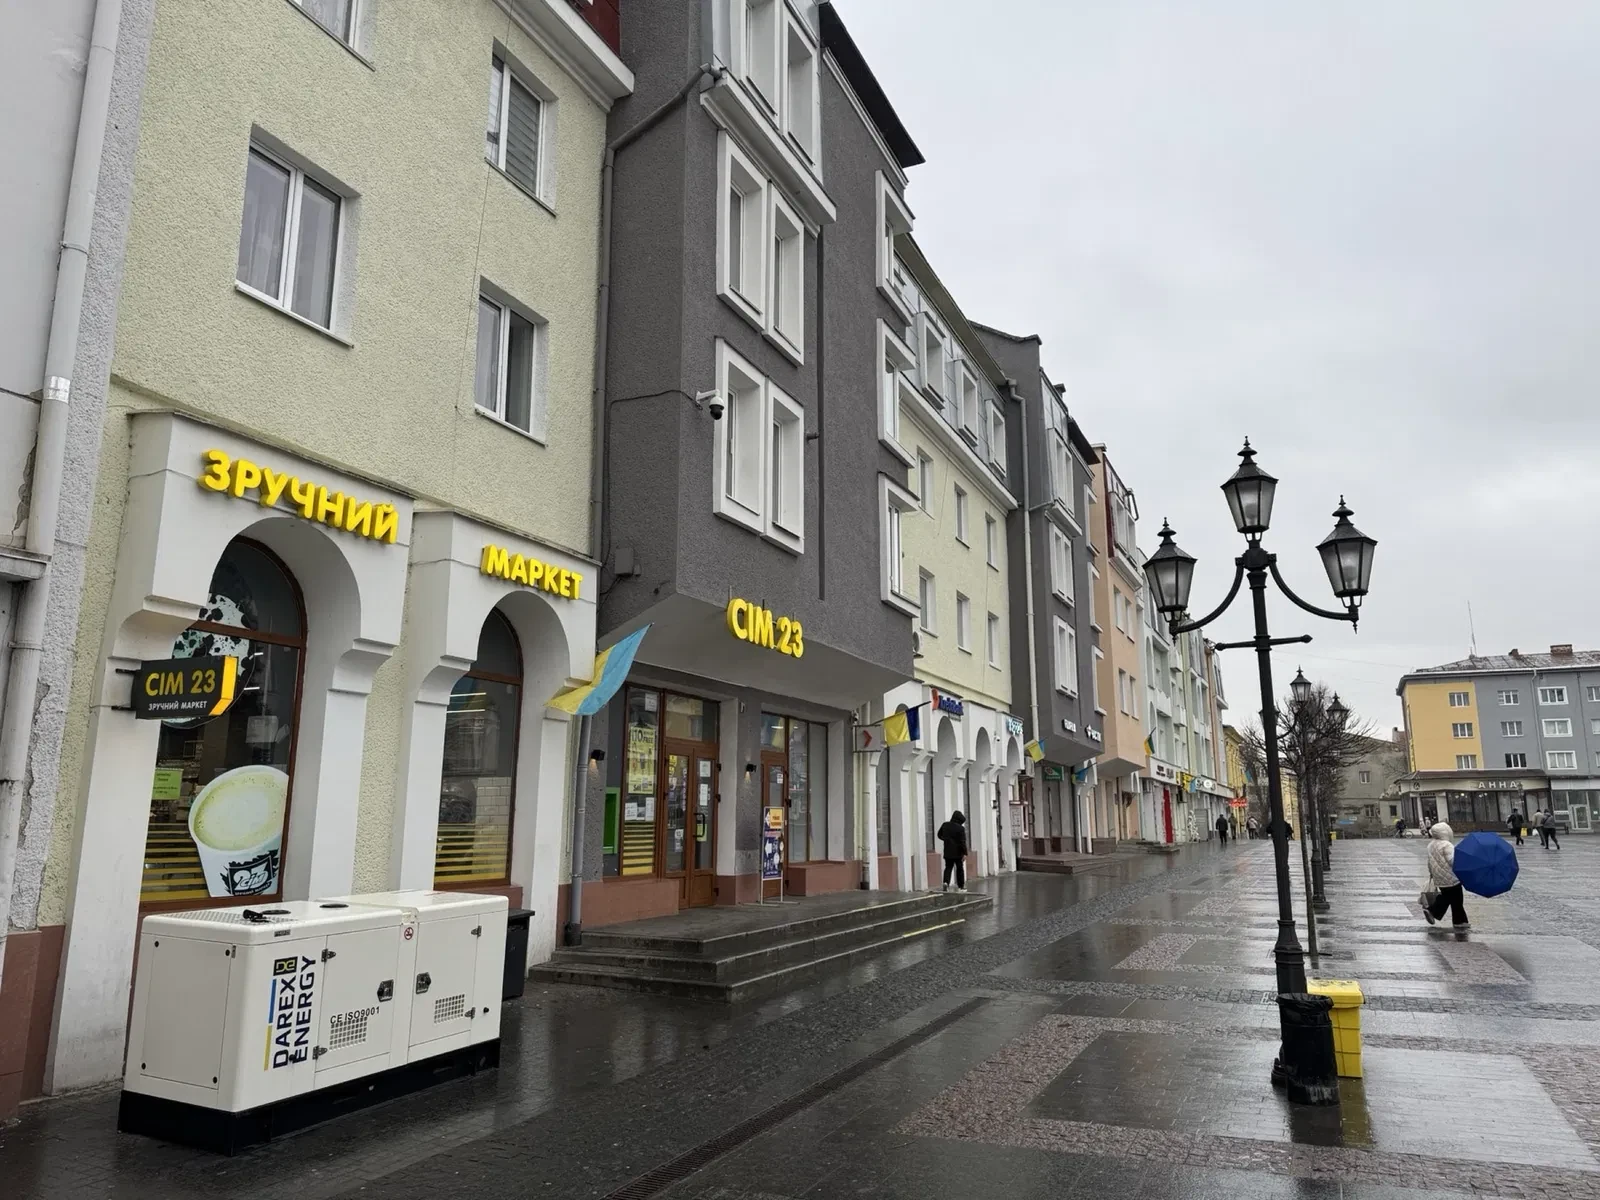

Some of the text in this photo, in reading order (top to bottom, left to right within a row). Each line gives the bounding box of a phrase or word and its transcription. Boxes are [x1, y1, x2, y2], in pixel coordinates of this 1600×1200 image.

[197, 449, 399, 544] ЗРУЧНИЙ
[481, 545, 583, 600] МАРКЕТ
[727, 598, 804, 658] СІМ 23
[145, 669, 216, 697] СІМ 23
[148, 701, 208, 711] ЗРУЧНИЙ МАРКЕТ
[1478, 781, 1517, 789] АННА
[273, 975, 296, 1069] DAREX
[291, 955, 316, 1064] ENERGY
[330, 1006, 380, 1024] CE ISO9001
